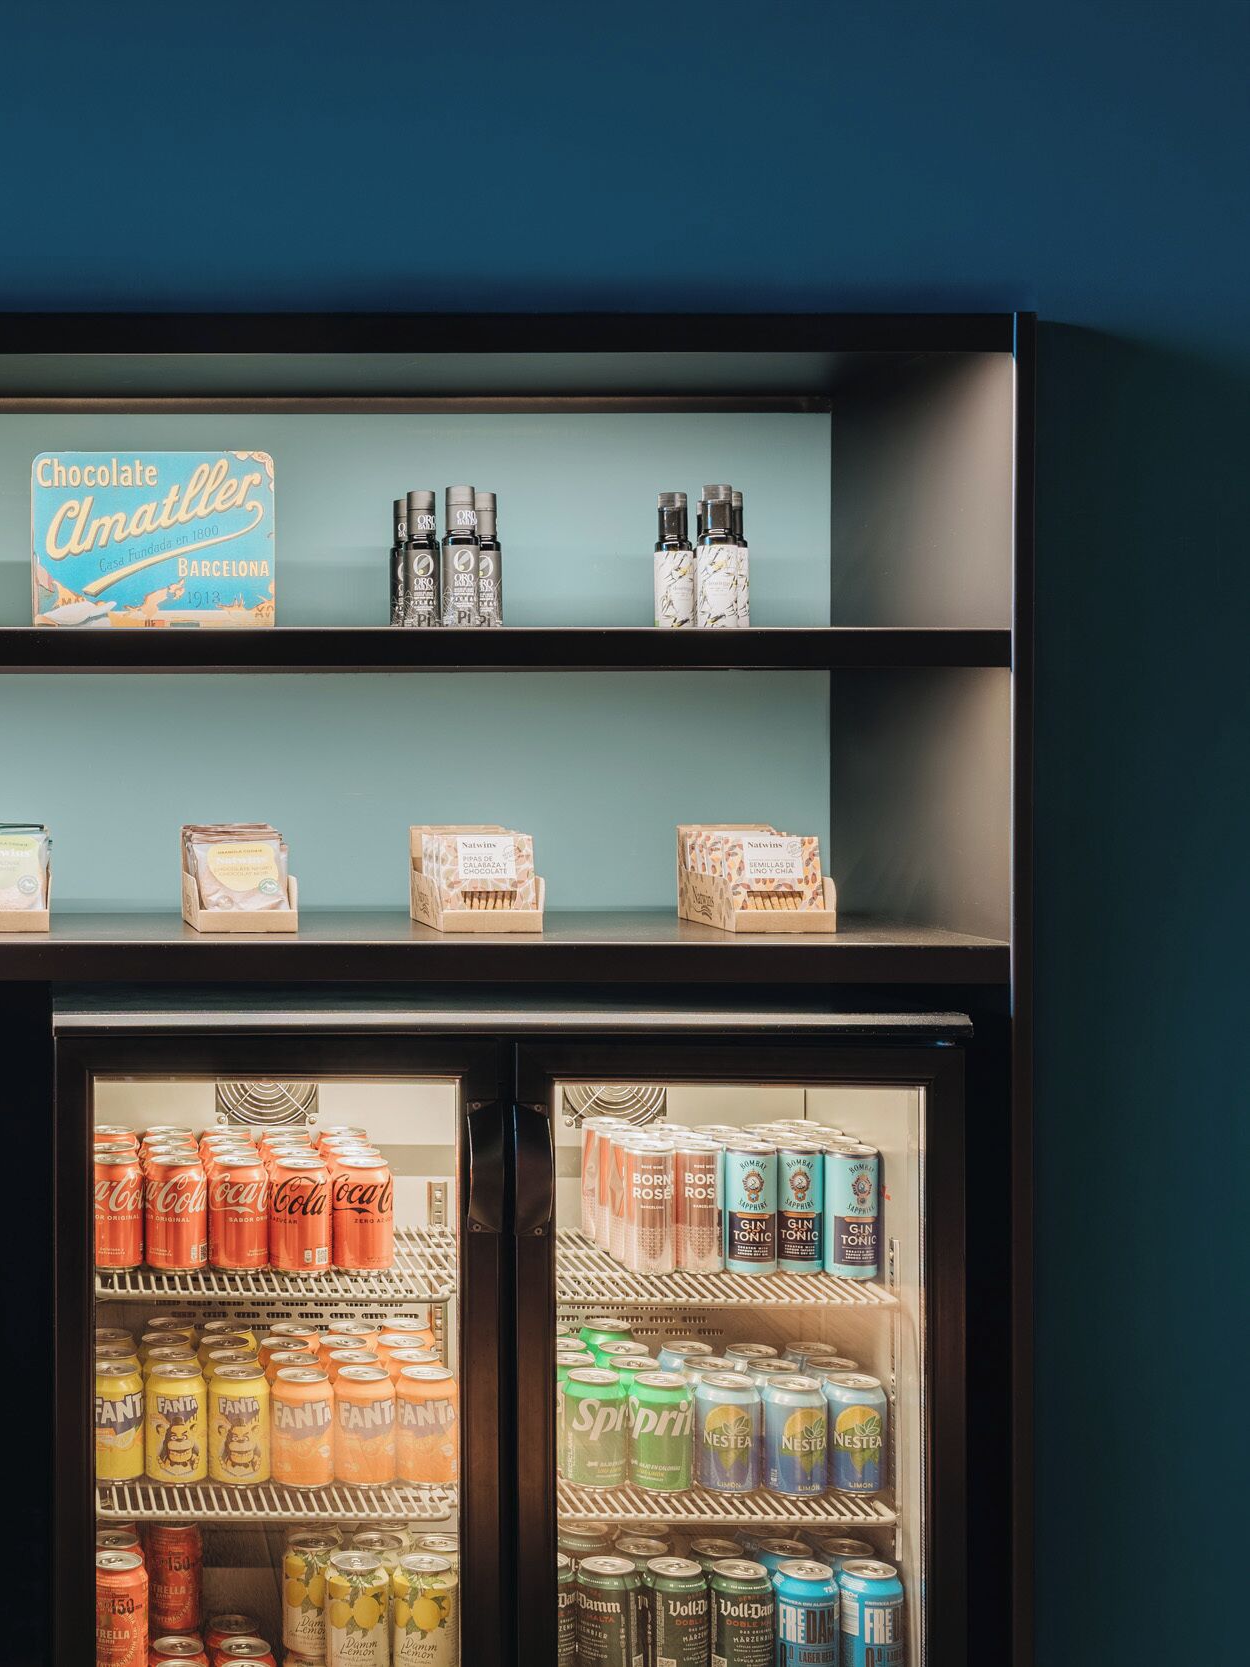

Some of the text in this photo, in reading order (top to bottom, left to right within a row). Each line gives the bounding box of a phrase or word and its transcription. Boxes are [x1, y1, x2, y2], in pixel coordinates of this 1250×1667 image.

[36, 458, 158, 488] Chocolate
[45, 458, 262, 561] Amatller
[99, 524, 220, 573] Casa Fundada en 1800
[178, 557, 270, 577] BARCELONA
[747, 841, 783, 849] Natwins
[632, 1173, 672, 1185] BORN
[684, 1172, 715, 1185] BOR
[210, 1172, 268, 1213] Coca-C
[632, 1185, 672, 1200] ROSÉ
[684, 1186, 715, 1199] ROS
[738, 1198, 768, 1211] SAPPHIRE
[784, 1197, 815, 1210] SAPPHIRE
[155, 1215, 191, 1223] ORIGINAL
[740, 1219, 766, 1230] GIN
[787, 1218, 813, 1229] GIN
[780, 1230, 819, 1241] TONIC
[849, 1224, 873, 1234] GIN
[733, 1230, 772, 1242] TONIC
[841, 1234, 877, 1246] TONIC
[96, 1391, 143, 1425] FANT
[157, 1395, 198, 1414] FANTA
[218, 1396, 260, 1416] FANTA
[272, 1399, 332, 1429] FANTA
[397, 1398, 456, 1427] FANTA
[703, 1430, 751, 1449] NESTEA
[781, 1435, 826, 1452] NESTEA
[833, 1431, 882, 1449] NESTEA
[725, 1618, 759, 1628] DOBLE
[345, 1636, 378, 1649] Damm
[405, 1636, 438, 1652] Damm
[340, 1643, 375, 1656] Lemon
[400, 1645, 434, 1659] Lemon
